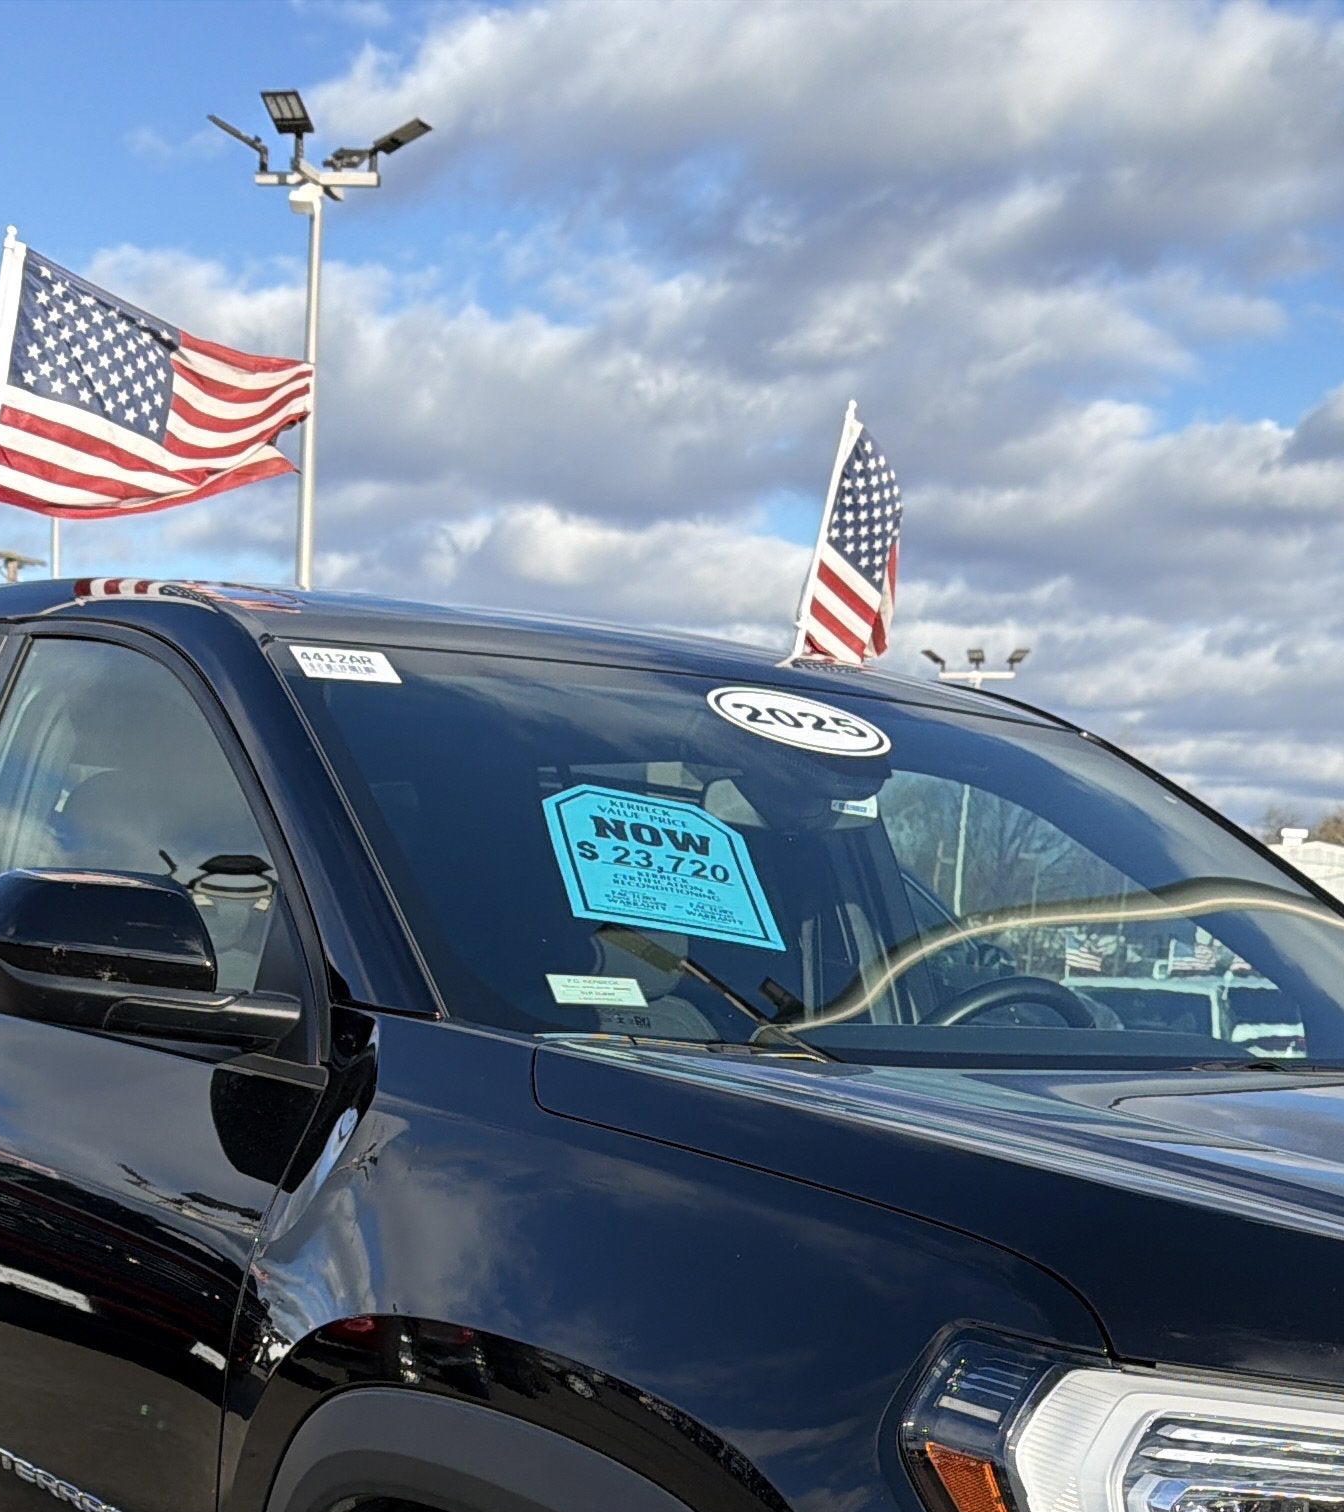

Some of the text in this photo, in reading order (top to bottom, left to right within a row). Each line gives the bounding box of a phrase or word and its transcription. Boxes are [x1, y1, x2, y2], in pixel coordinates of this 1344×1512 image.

[732, 703, 868, 738] 2025
[597, 804, 689, 828] VALUE PRICE
[609, 799, 671, 818] KERBECK
[590, 815, 711, 857] NOW
[576, 840, 730, 884] $ 23,720
